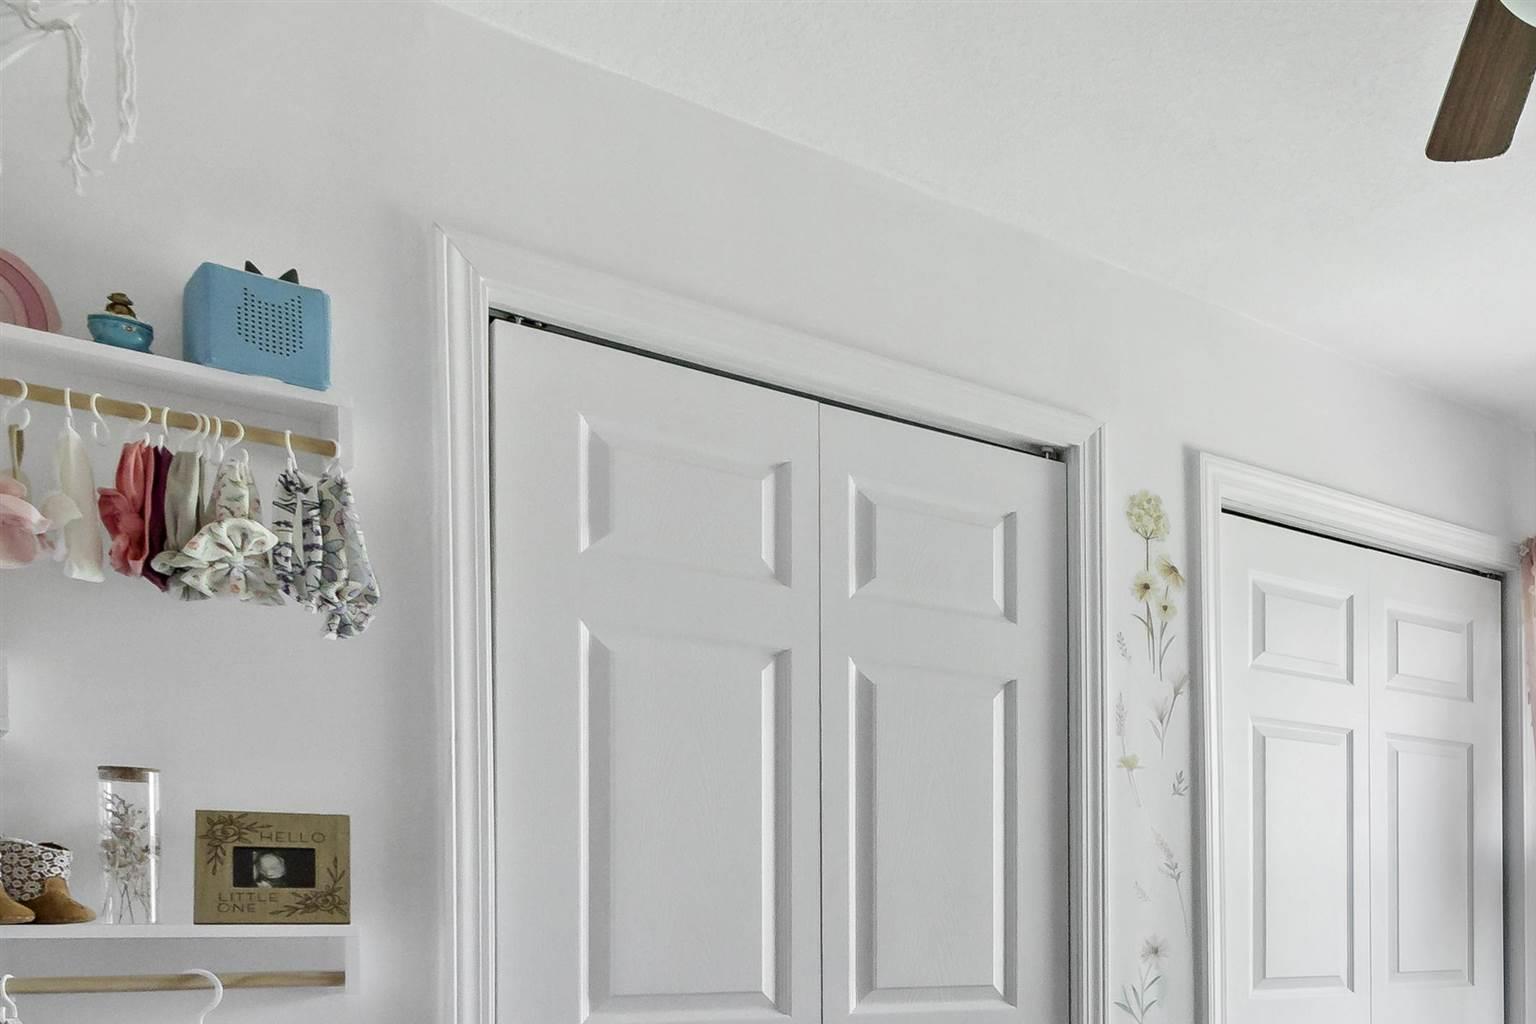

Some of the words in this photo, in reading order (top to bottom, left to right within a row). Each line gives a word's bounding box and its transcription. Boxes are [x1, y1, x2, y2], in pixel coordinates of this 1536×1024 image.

[260, 832, 326, 844] HELLO
[218, 891, 279, 902] LITTLE
[217, 903, 256, 913] ONE
